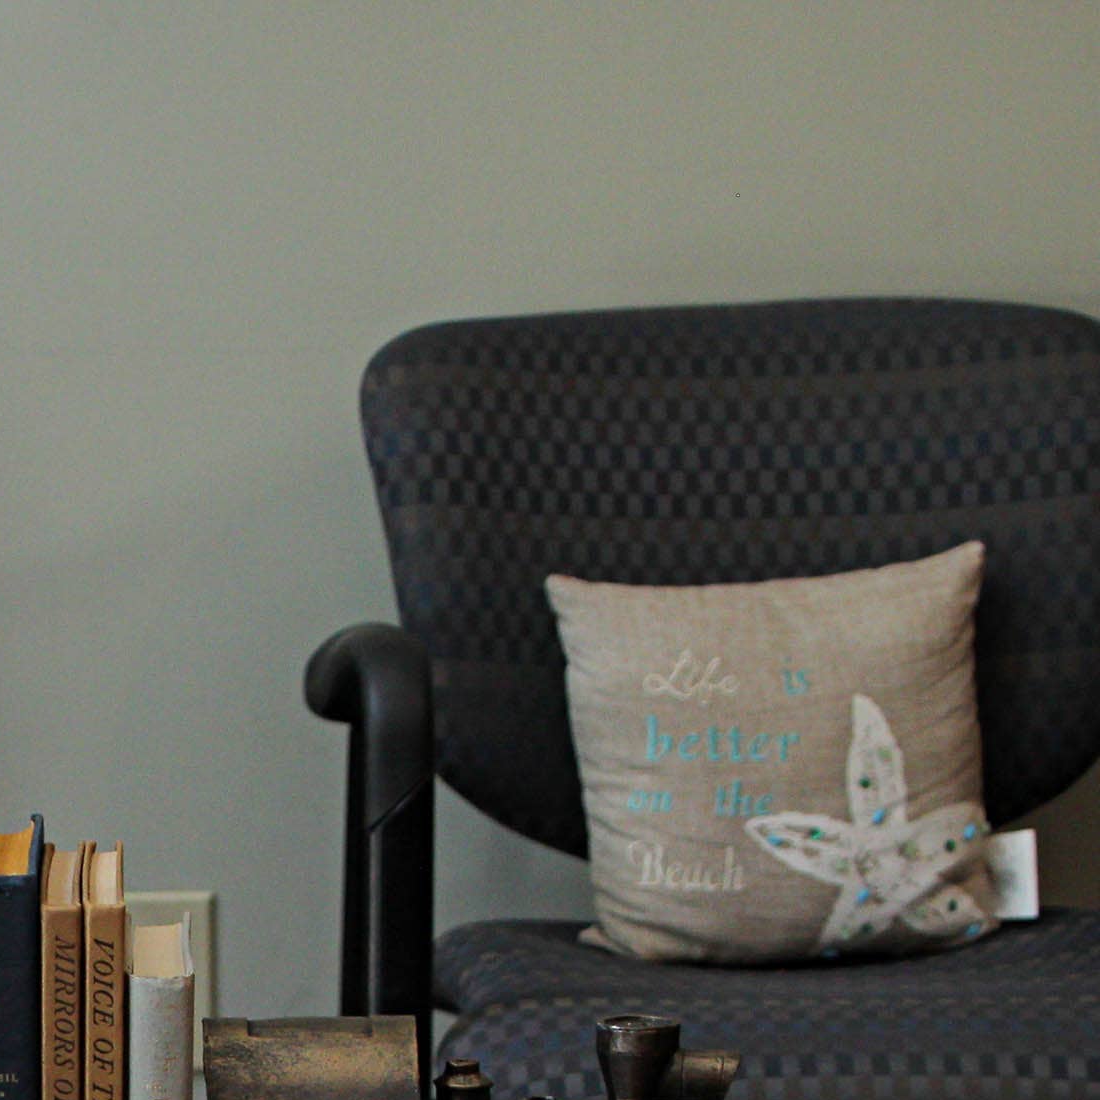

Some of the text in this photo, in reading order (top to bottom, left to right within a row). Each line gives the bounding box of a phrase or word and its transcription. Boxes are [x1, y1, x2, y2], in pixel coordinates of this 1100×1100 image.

[643, 650, 811, 705] Life is
[645, 714, 799, 763] better
[627, 779, 773, 817] on the
[627, 840, 745, 893] Beach
[53, 935, 77, 1071] MIRRORS
[92, 937, 115, 1028] VOICE
[93, 1039, 114, 1075] OF
